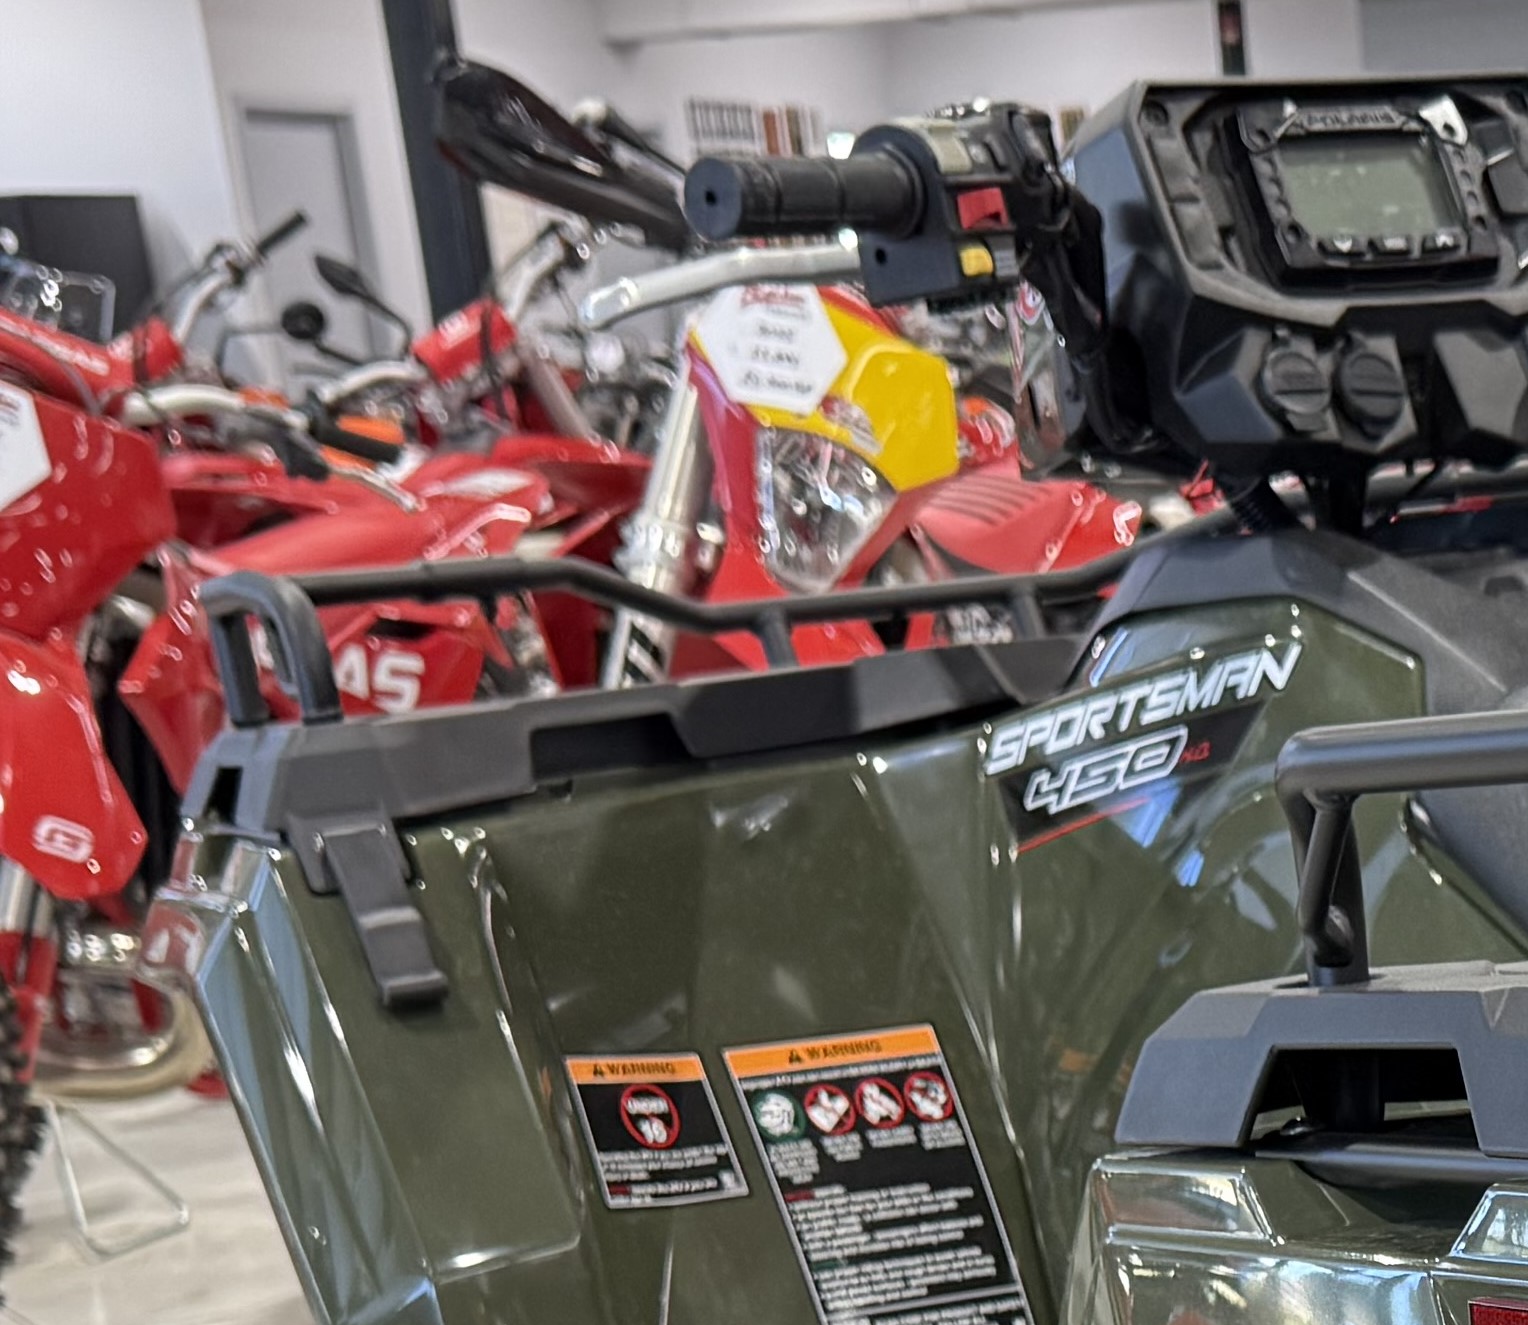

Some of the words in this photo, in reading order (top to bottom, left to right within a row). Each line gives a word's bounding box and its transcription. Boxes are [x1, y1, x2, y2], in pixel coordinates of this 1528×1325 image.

[984, 642, 1302, 775] SPORTSMAN
[1024, 725, 1188, 814] 450
[607, 1060, 677, 1077] WARNING
[808, 1040, 882, 1061] WARNING
